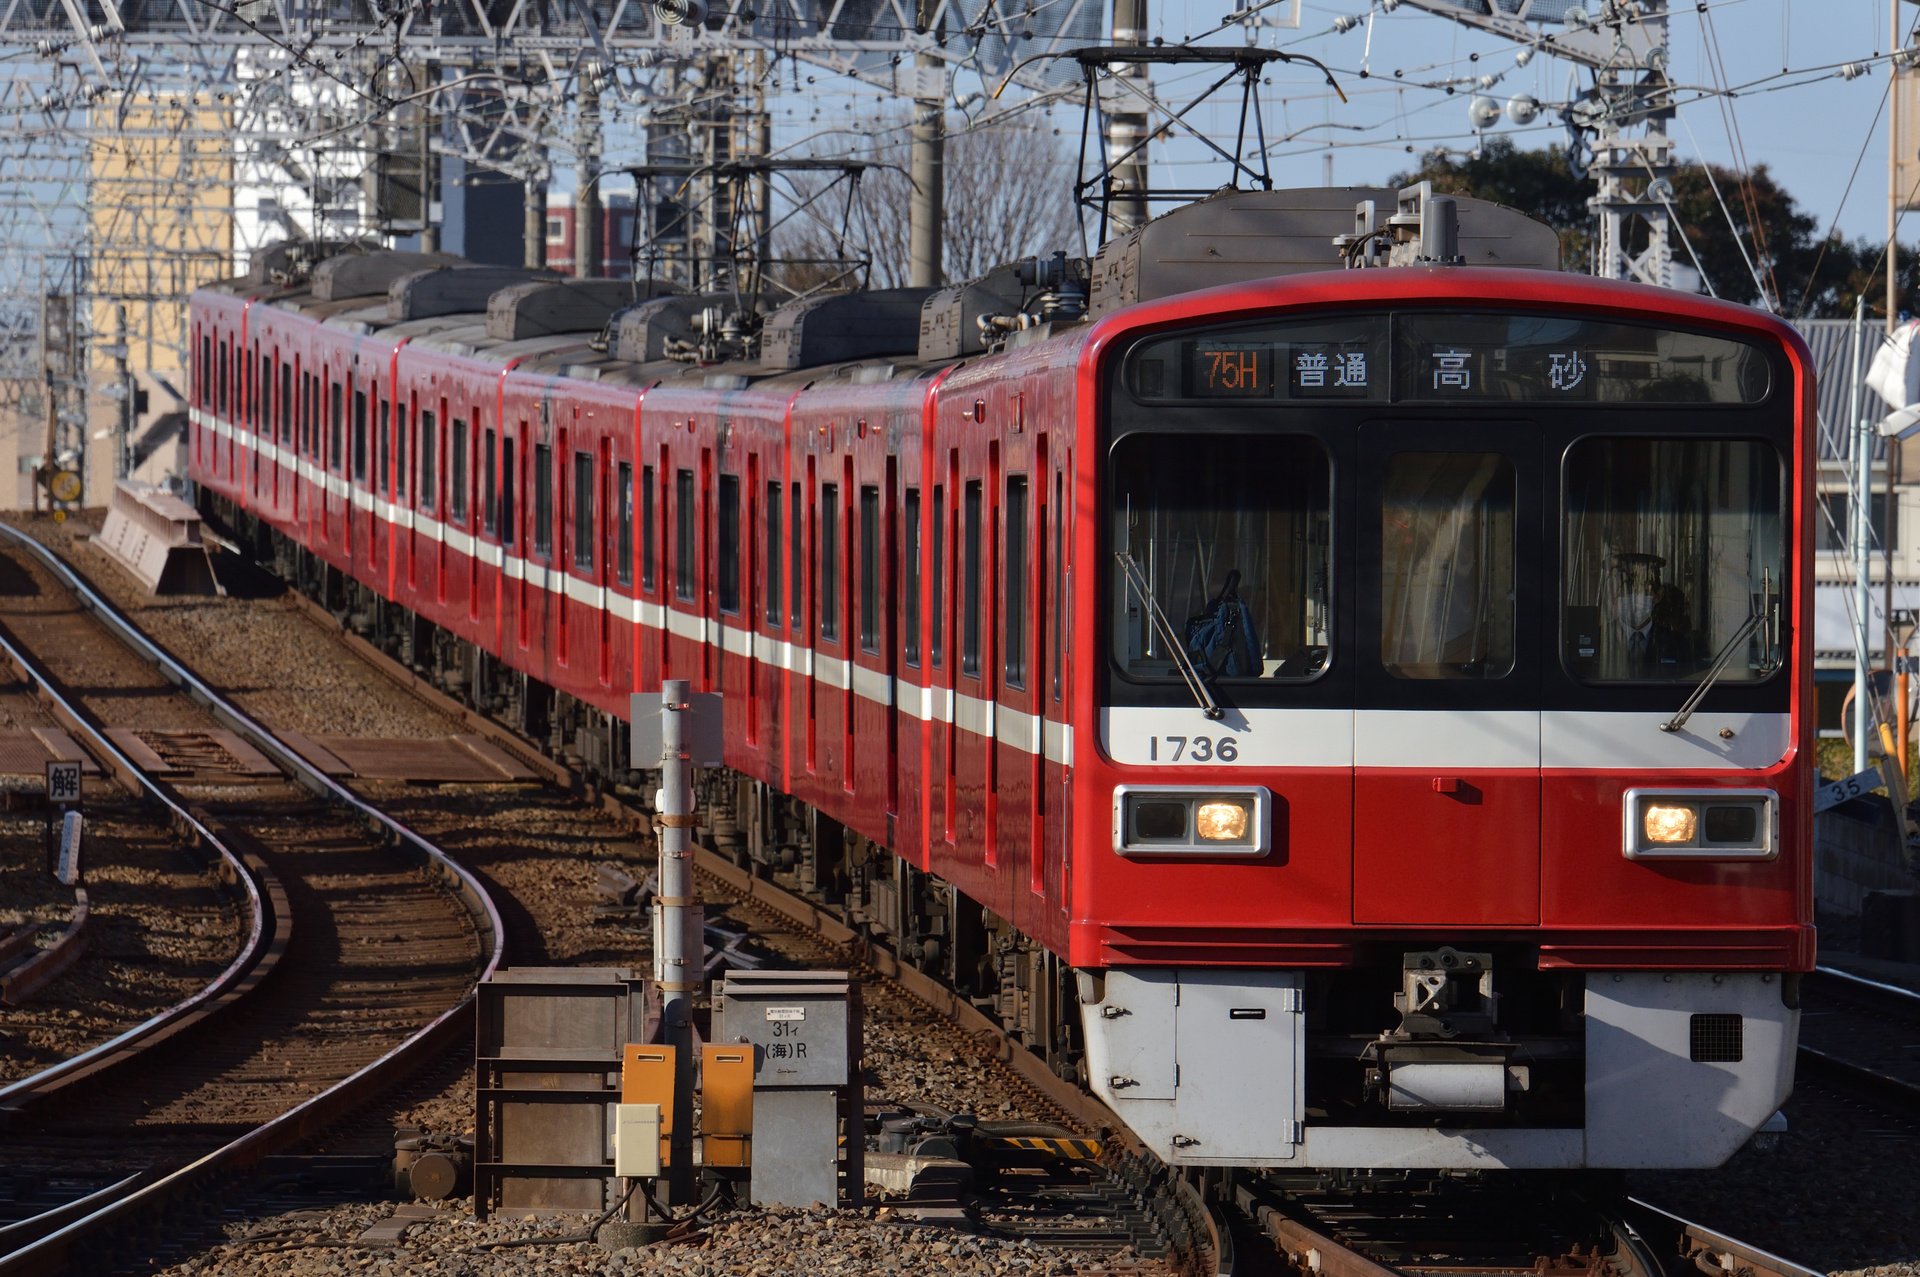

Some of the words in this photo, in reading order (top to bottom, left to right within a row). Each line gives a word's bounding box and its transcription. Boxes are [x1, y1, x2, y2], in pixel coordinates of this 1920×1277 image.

[1204, 351, 1257, 388] 75H
[1296, 353, 1368, 387] 普通
[1150, 735, 1238, 762] 1736
[51, 767, 78, 797] 解
[1831, 778, 1861, 802] 35
